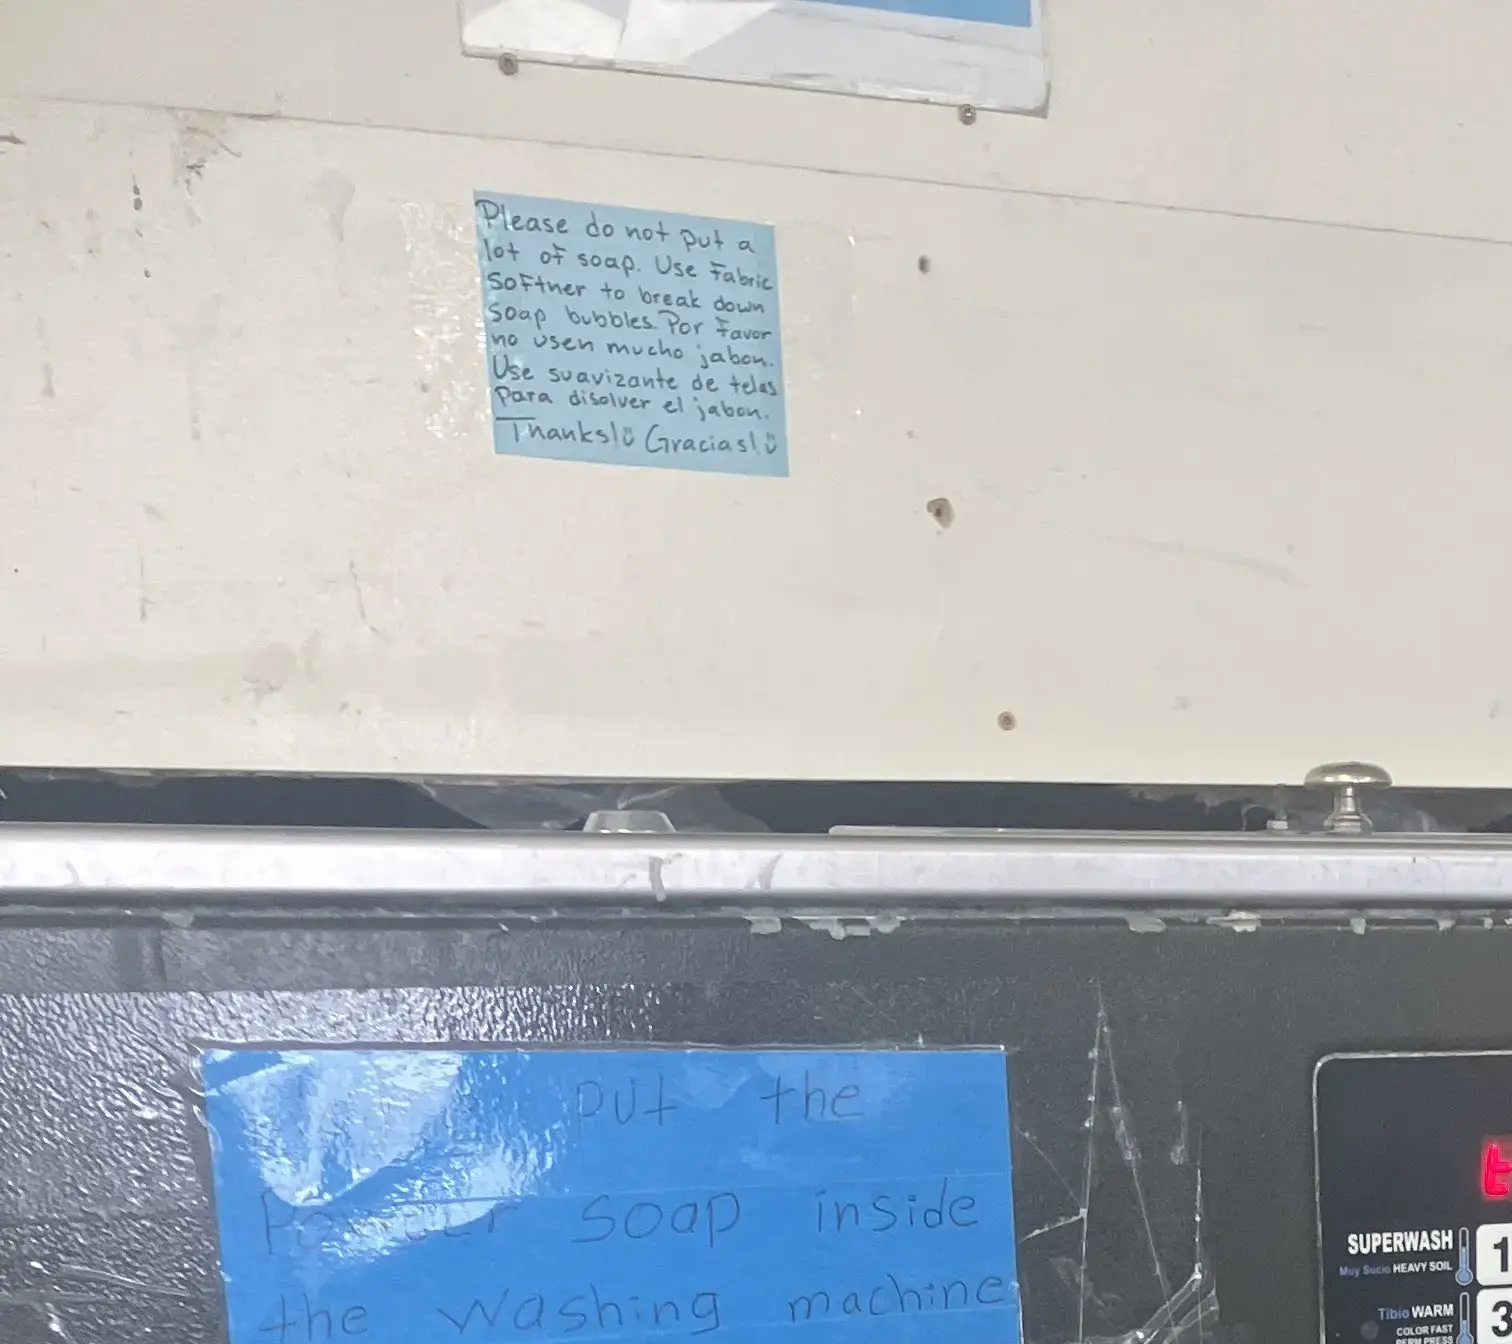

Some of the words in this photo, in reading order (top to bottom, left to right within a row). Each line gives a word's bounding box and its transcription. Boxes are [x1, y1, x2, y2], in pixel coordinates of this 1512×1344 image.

[475, 199, 568, 234] Please
[586, 211, 614, 237] do
[625, 221, 669, 242] not
[739, 240, 755, 253] a
[484, 238, 519, 262] lot
[577, 252, 641, 278] soap.
[655, 255, 696, 277] Use
[600, 282, 624, 300] to
[638, 286, 701, 308] break
[714, 295, 765, 314] down
[565, 305, 658, 330] bubbles.
[658, 310, 703, 335] Por
[492, 334, 518, 347] no
[533, 335, 593, 351] usen
[607, 338, 684, 359] mucho
[697, 344, 773, 369] jabon.
[493, 355, 533, 380] Use
[549, 367, 678, 389] suavizante
[692, 373, 718, 392] de
[730, 375, 778, 396] telas
[569, 390, 651, 410] disolver
[663, 397, 683, 413] el
[693, 397, 770, 422] jabon.
[645, 424, 760, 455] Gracias!
[761, 1071, 864, 1125] the
[815, 1177, 979, 1234] inside
[1348, 1229, 1453, 1254] SUPERWASH
[1493, 1236, 1508, 1272] 1
[1393, 1262, 1426, 1273] HEAVY
[1430, 1262, 1453, 1271] SOIL
[789, 1273, 1006, 1323] machine
[1412, 1304, 1453, 1319] WARM
[1396, 1327, 1429, 1336] COLOR
[1431, 1324, 1453, 1334] FAST
[1424, 1336, 1453, 1344] PRESS
